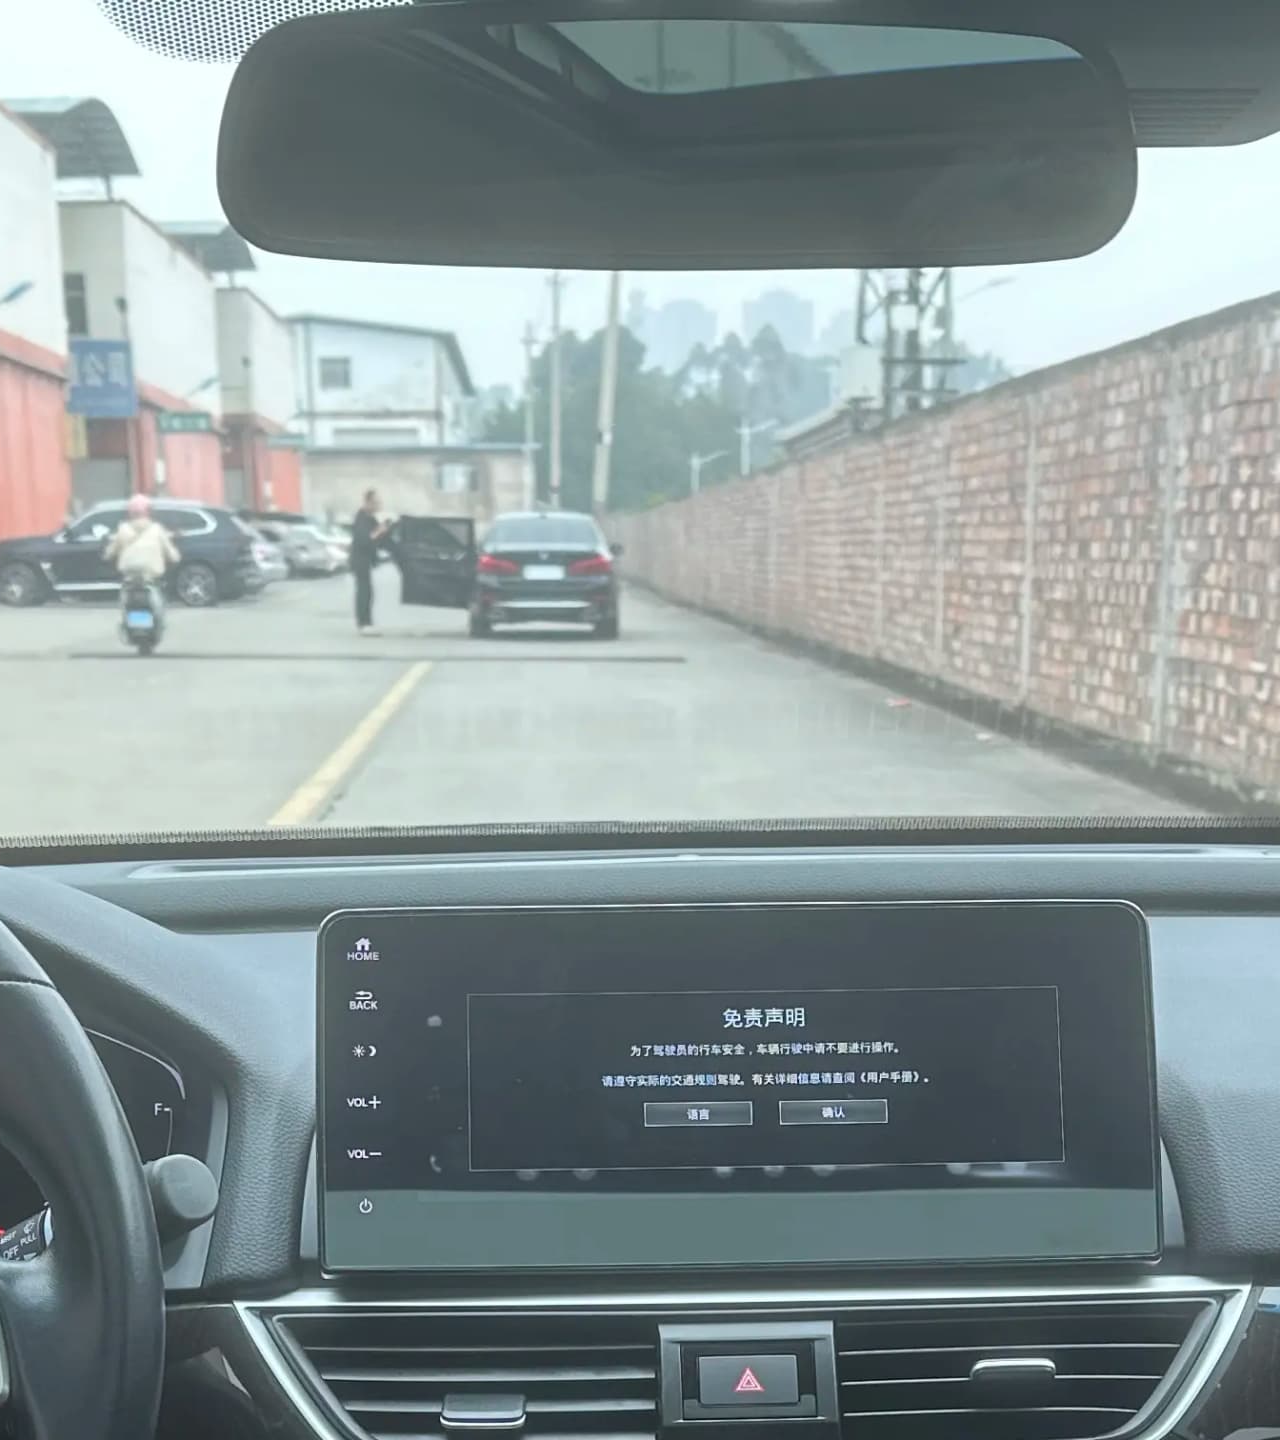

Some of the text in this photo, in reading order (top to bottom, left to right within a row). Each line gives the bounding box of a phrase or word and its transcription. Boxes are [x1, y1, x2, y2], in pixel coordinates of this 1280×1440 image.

[347, 951, 380, 961] HOME
[349, 1001, 378, 1010] BACK
[723, 1007, 806, 1028] 免责声明
[154, 1103, 163, 1116] F
[687, 1109, 710, 1121] 语言
[821, 1106, 845, 1119] 确认
[20, 1232, 38, 1247] PULL
